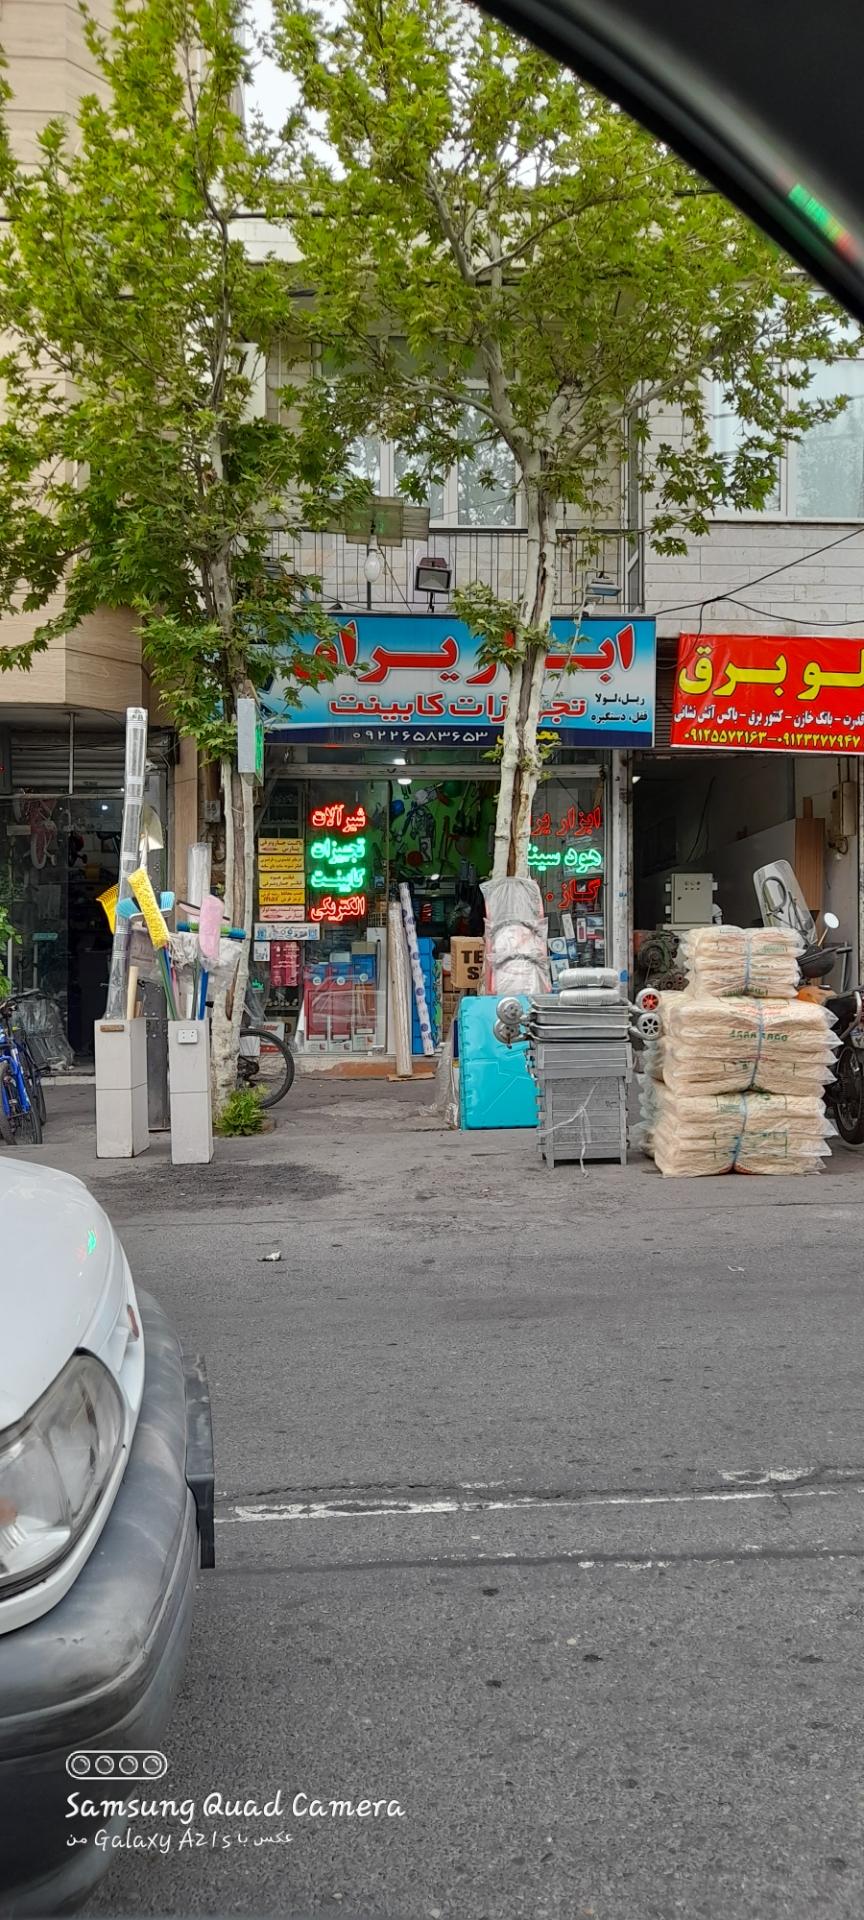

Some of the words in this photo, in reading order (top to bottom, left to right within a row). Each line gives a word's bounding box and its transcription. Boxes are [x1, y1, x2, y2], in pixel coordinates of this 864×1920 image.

[678, 644, 788, 698] برق
[329, 692, 445, 722] کابینت
[674, 704, 697, 723] نشانی
[697, 704, 716, 723] آتش
[716, 706, 738, 724] باکس
[747, 709, 763, 726] برق
[590, 712, 627, 724] دستگیره
[793, 710, 814, 728] خازن
[815, 711, 833, 728] بانک
[352, 730, 489, 742] ۰۹۲۲۶۵۸۳۶۵۳
[312, 804, 345, 827] آلات
[342, 806, 366, 833] شیر
[556, 806, 602, 836] ابزار
[311, 837, 366, 865] تجهیزات
[311, 866, 366, 893] کابینت
[311, 896, 366, 922] الکتریکی
